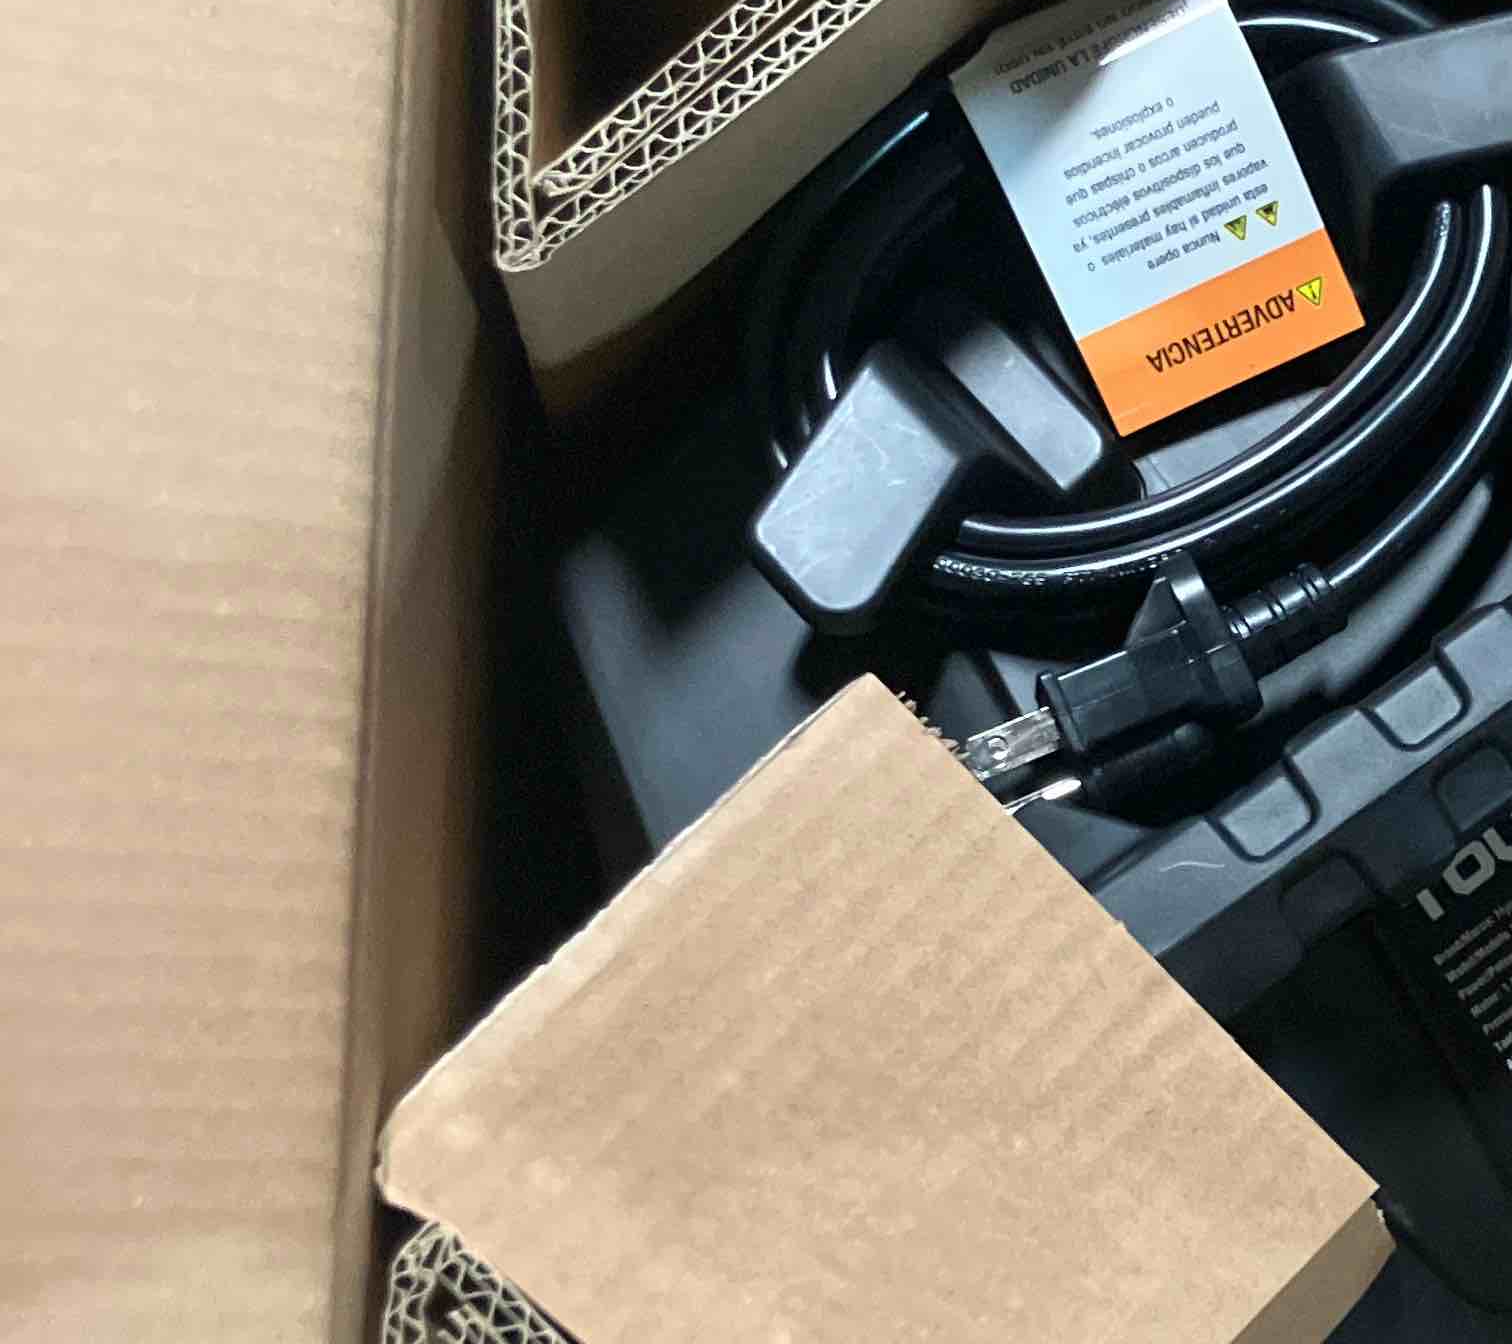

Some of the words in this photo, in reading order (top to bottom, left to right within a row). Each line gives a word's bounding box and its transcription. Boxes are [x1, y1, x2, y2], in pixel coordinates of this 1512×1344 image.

[1176, 100, 1221, 129] pueden
[1124, 121, 1174, 154] provocar
[1183, 119, 1238, 152] producen
[1063, 148, 1121, 180] incendios
[1148, 146, 1181, 168] arcos
[1203, 154, 1223, 169] los
[1223, 142, 1246, 160] que
[1090, 167, 1136, 194] chispas
[1132, 163, 1201, 201] dispositivos
[1222, 159, 1268, 186] vapores
[1065, 188, 1089, 206] que
[1152, 181, 1220, 217] inflamables
[1242, 183, 1268, 201] esta
[1072, 195, 1131, 228] eléctricos
[1188, 214, 1200, 229] si
[1201, 195, 1242, 223] unidad
[1089, 209, 1151, 244] presentes,
[1165, 221, 1188, 237] hay
[1072, 237, 1089, 253] ya
[1101, 232, 1163, 266] materiales
[1181, 231, 1221, 254] Nunca
[1087, 261, 1096, 272] o
[1147, 248, 1180, 270] opere
[1147, 290, 1295, 372] ADVERTENCIA
